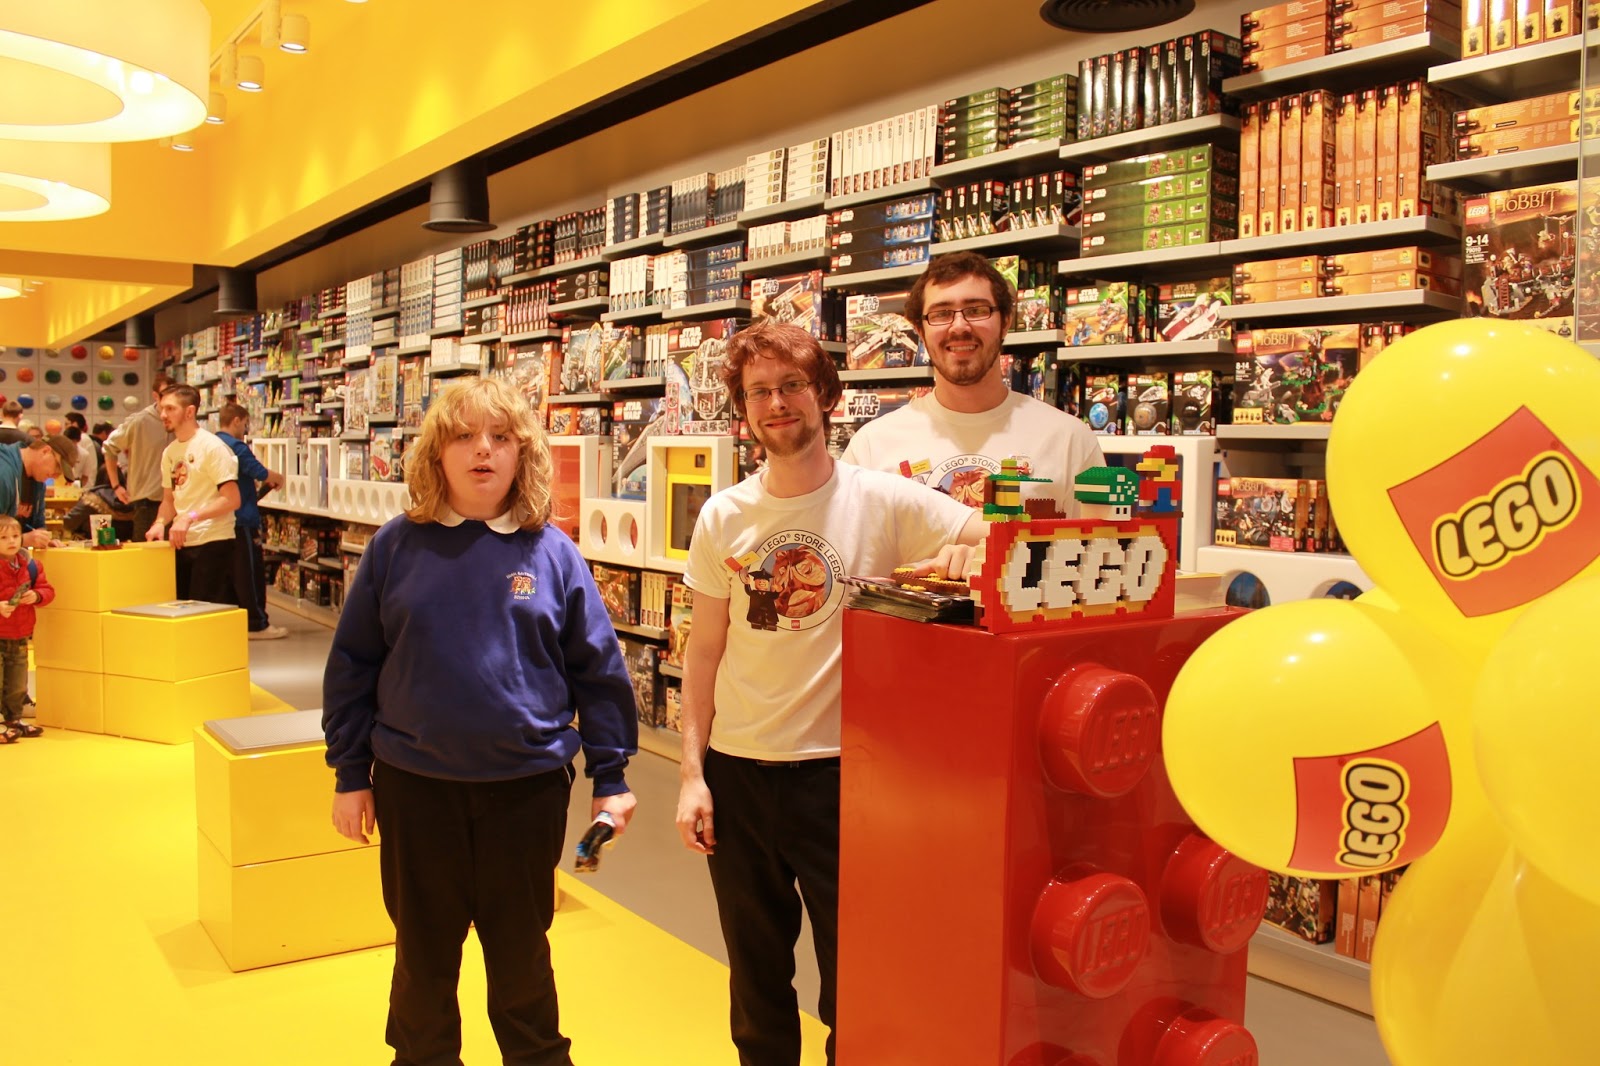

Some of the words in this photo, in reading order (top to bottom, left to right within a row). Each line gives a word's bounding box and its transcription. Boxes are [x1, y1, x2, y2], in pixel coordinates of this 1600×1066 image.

[1467, 205, 1489, 218] LEGO
[1465, 233, 1489, 247] 9-14
[849, 395, 879, 406] STAR
[848, 405, 879, 416] WARS
[971, 457, 1000, 473] STORE
[1436, 456, 1577, 577] LEGO
[794, 533, 826, 551] STORE
[824, 549, 842, 579] LEEDS
[1005, 535, 1168, 612] LEGO
[1340, 763, 1404, 867] LEGO
